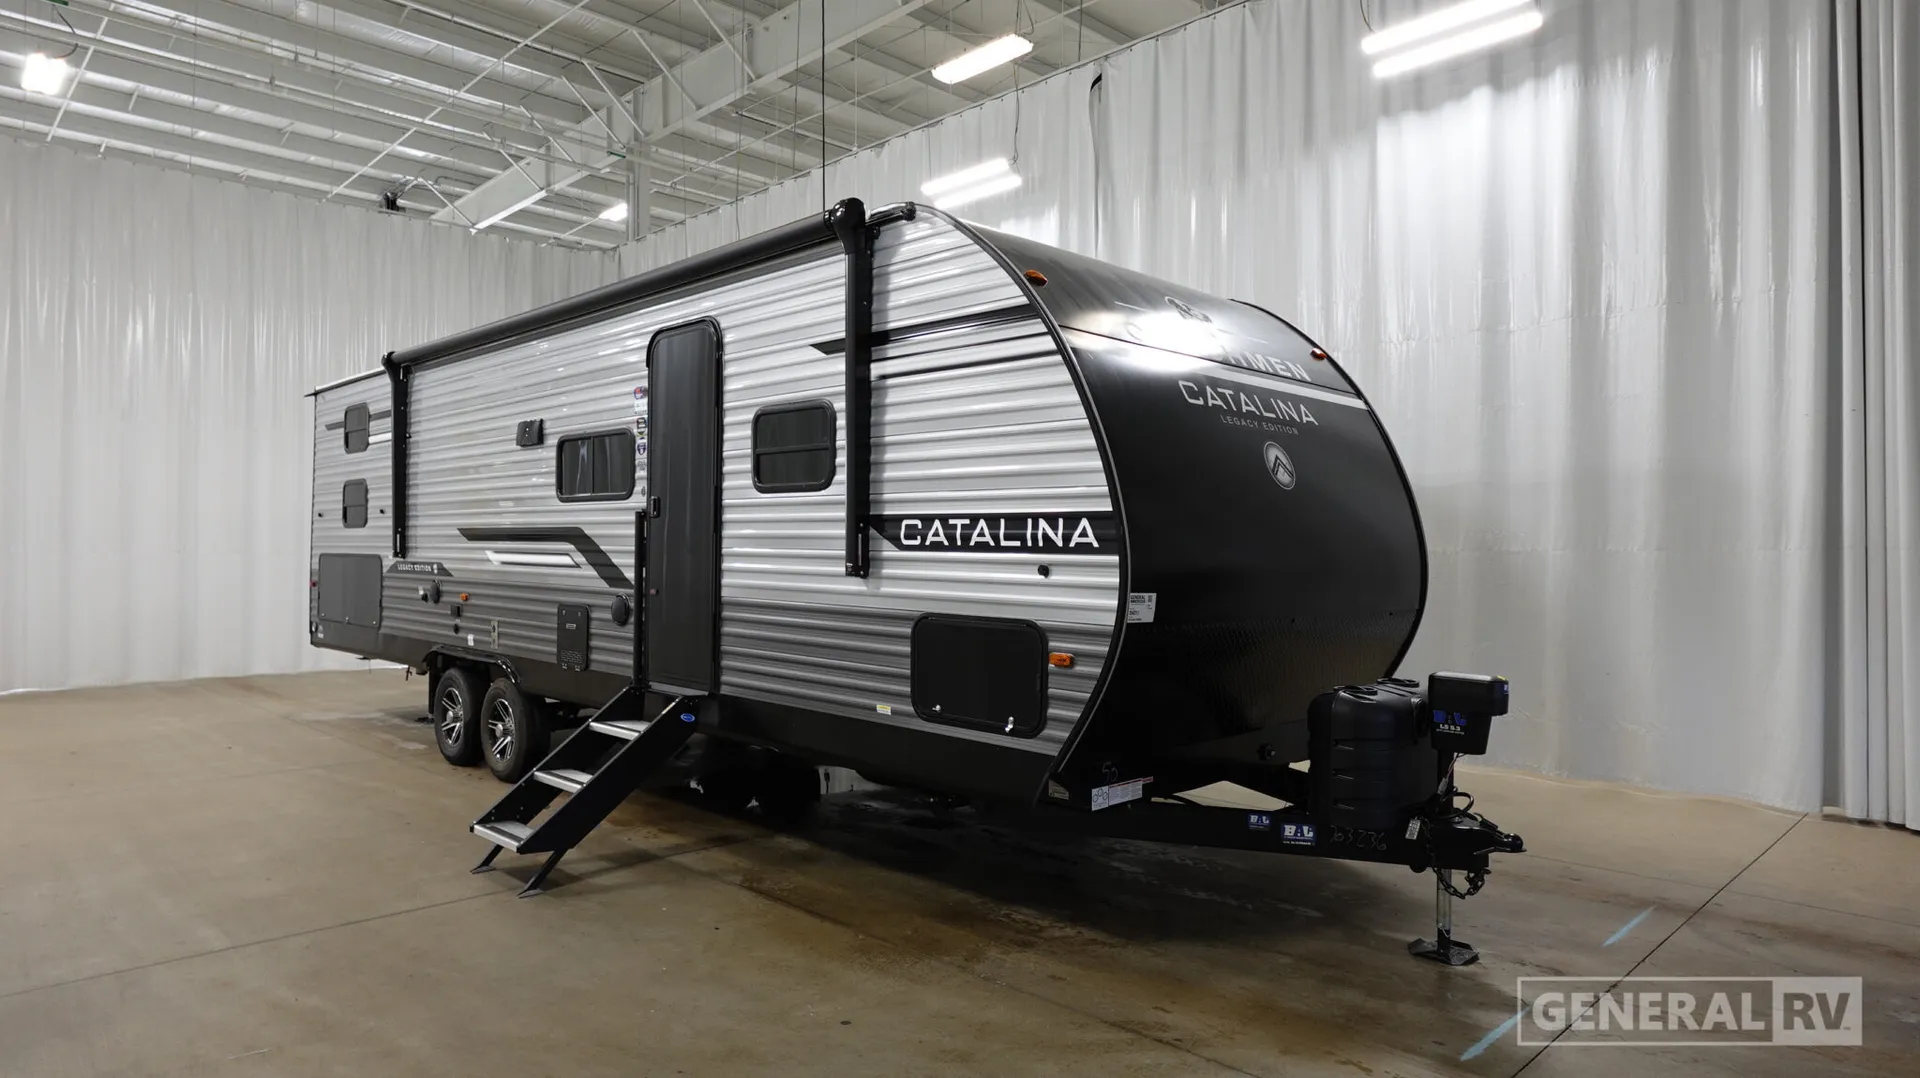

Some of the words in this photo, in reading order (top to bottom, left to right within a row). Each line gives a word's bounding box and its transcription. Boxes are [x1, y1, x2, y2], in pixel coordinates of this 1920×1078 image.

[1178, 380, 1319, 426] CATALINA
[1220, 415, 1259, 429] LEGACY
[1262, 421, 1299, 436] EDITION
[900, 517, 1100, 548] CATALINA
[397, 563, 414, 571] LEGACY
[414, 564, 432, 572] EDITION
